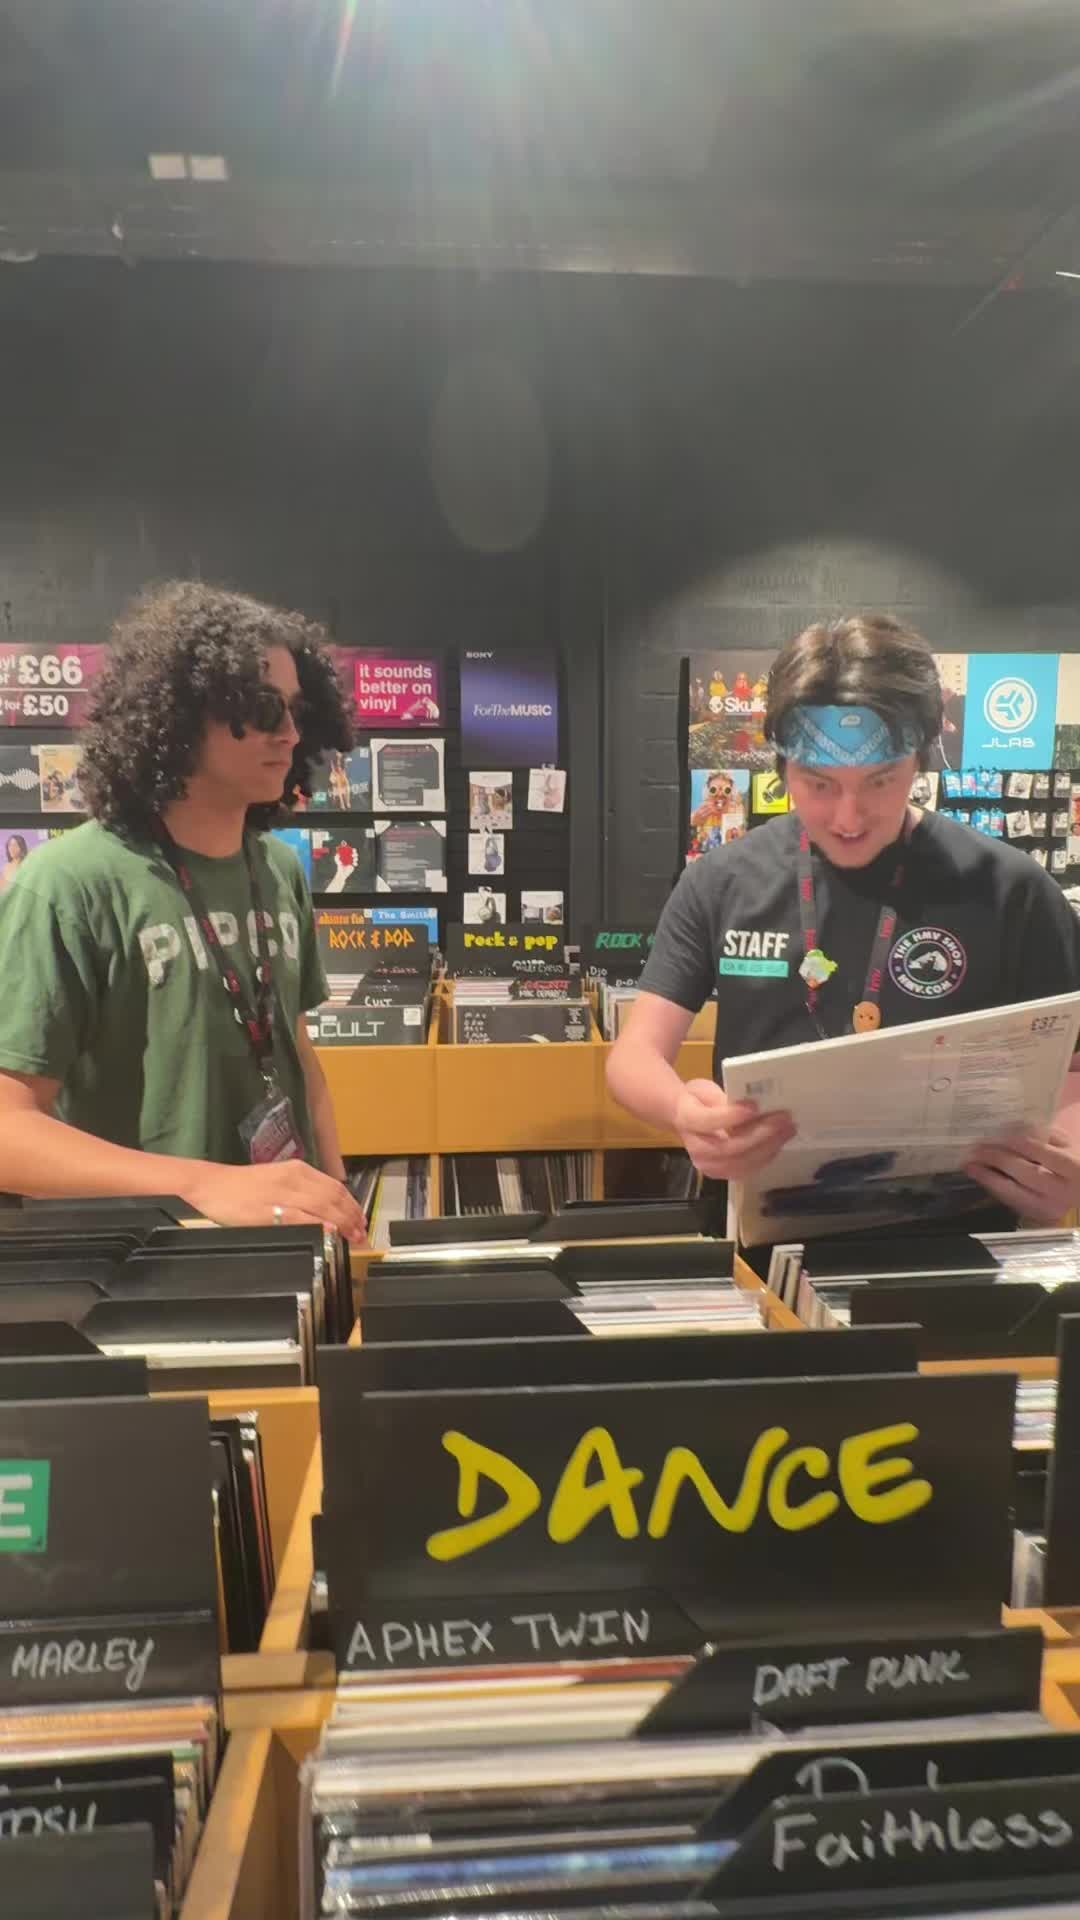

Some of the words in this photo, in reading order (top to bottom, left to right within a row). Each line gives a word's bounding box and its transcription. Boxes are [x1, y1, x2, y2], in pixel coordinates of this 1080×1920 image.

[0, 655, 16, 672] yl
[18, 655, 83, 685] £66
[360, 664, 369, 678] it
[374, 664, 432, 679] sounds
[360, 681, 407, 694] better
[411, 682, 432, 695] on
[22, 694, 69, 717] £50
[360, 696, 397, 712] vinyl
[981, 737, 1036, 748] JLAB
[329, 928, 366, 949] ROCK
[384, 927, 415, 948] POP
[463, 931, 506, 948] rock
[524, 935, 559, 951] pop
[594, 931, 642, 949] ROCK
[723, 929, 790, 958] STAFF
[893, 939, 913, 959] THE
[912, 930, 942, 943] HMV
[319, 1021, 384, 1038] CULT
[425, 1422, 935, 1563] DANCE
[347, 1617, 497, 1666] APHEX
[511, 1607, 653, 1650] TWIN
[11, 1635, 156, 1693] MARLEY
[751, 1655, 852, 1705] DAFT
[865, 1649, 971, 1695] PUNK
[772, 1803, 1075, 1873] Faithless
